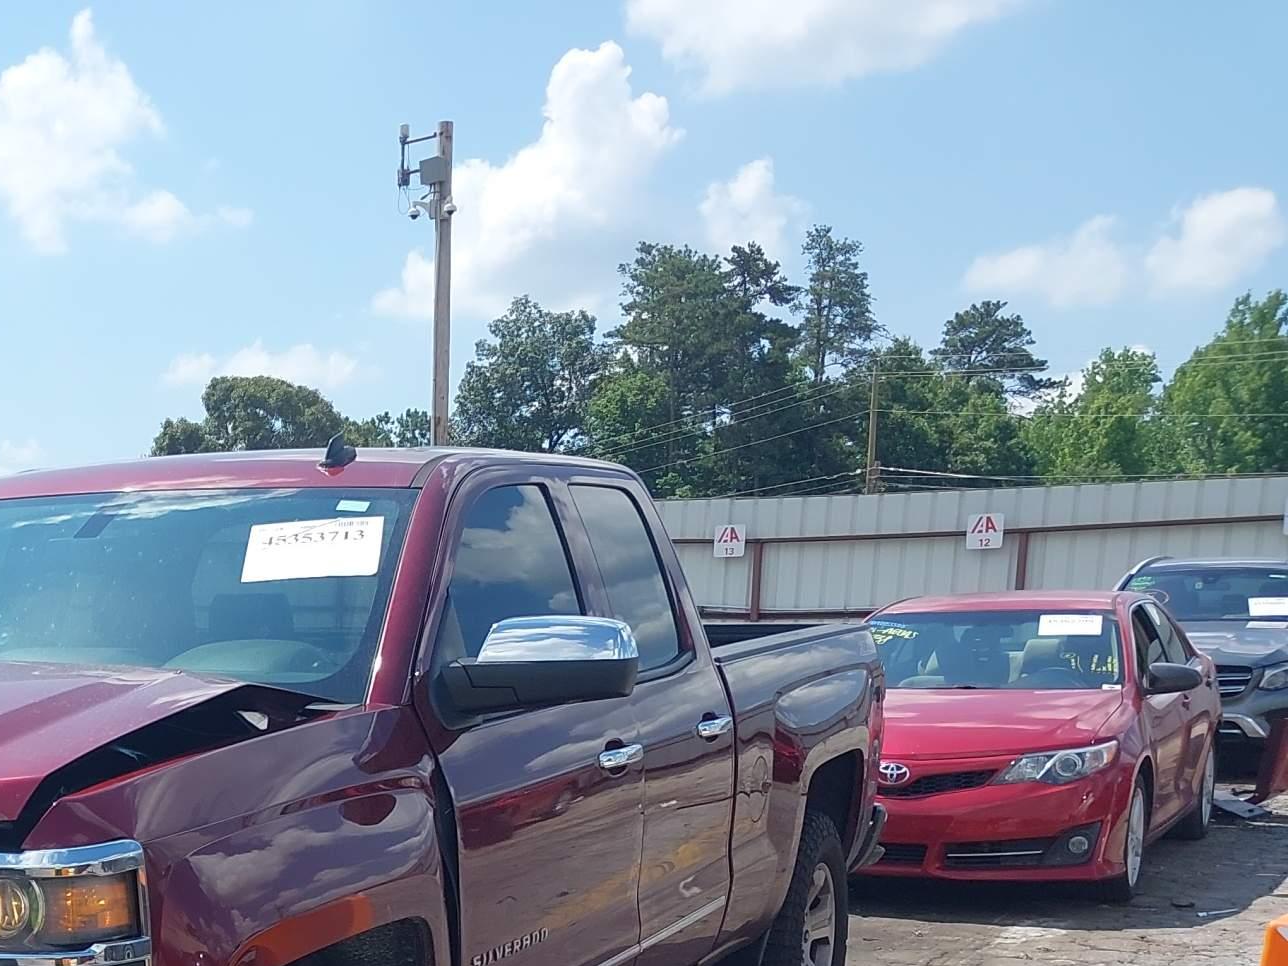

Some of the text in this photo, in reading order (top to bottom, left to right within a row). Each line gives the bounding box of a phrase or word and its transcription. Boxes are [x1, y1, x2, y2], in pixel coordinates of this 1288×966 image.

[261, 529, 366, 546] 45353713
[978, 538, 991, 548] 12
[724, 547, 735, 556] 13
